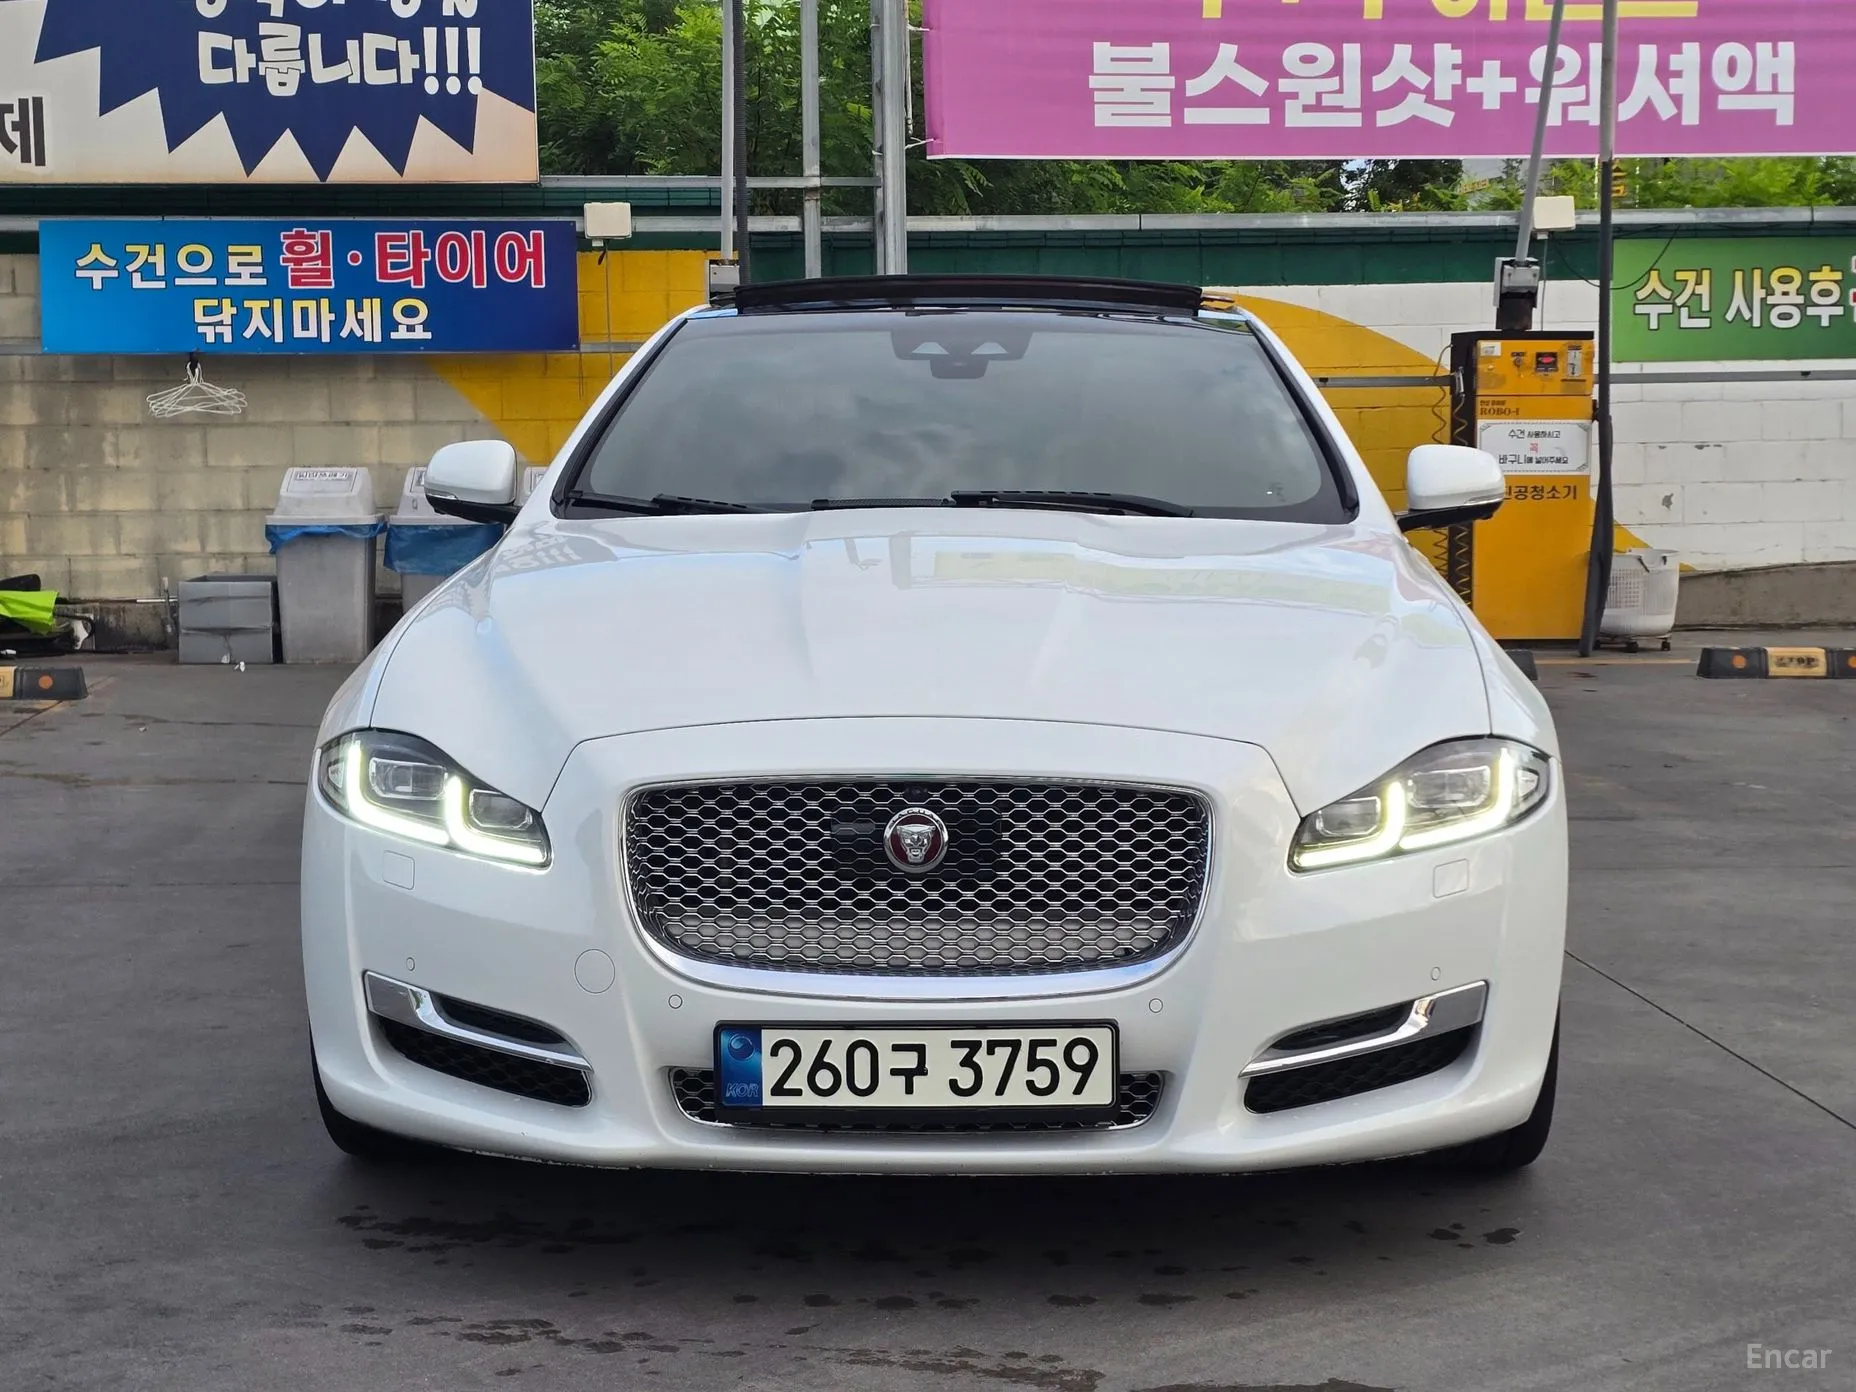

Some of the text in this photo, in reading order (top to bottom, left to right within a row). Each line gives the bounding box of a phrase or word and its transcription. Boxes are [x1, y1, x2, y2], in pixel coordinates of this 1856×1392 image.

[199, 23, 482, 97] 다룹니다!!!
[75, 243, 267, 290] 수건으로
[193, 298, 432, 343] 닦지마세요
[1633, 268, 1711, 330] 수건
[1725, 265, 1844, 329] 사용후
[1508, 429, 1525, 439] 수건
[726, 1082, 759, 1097] KOR
[769, 1037, 1099, 1098] 260구 3759
